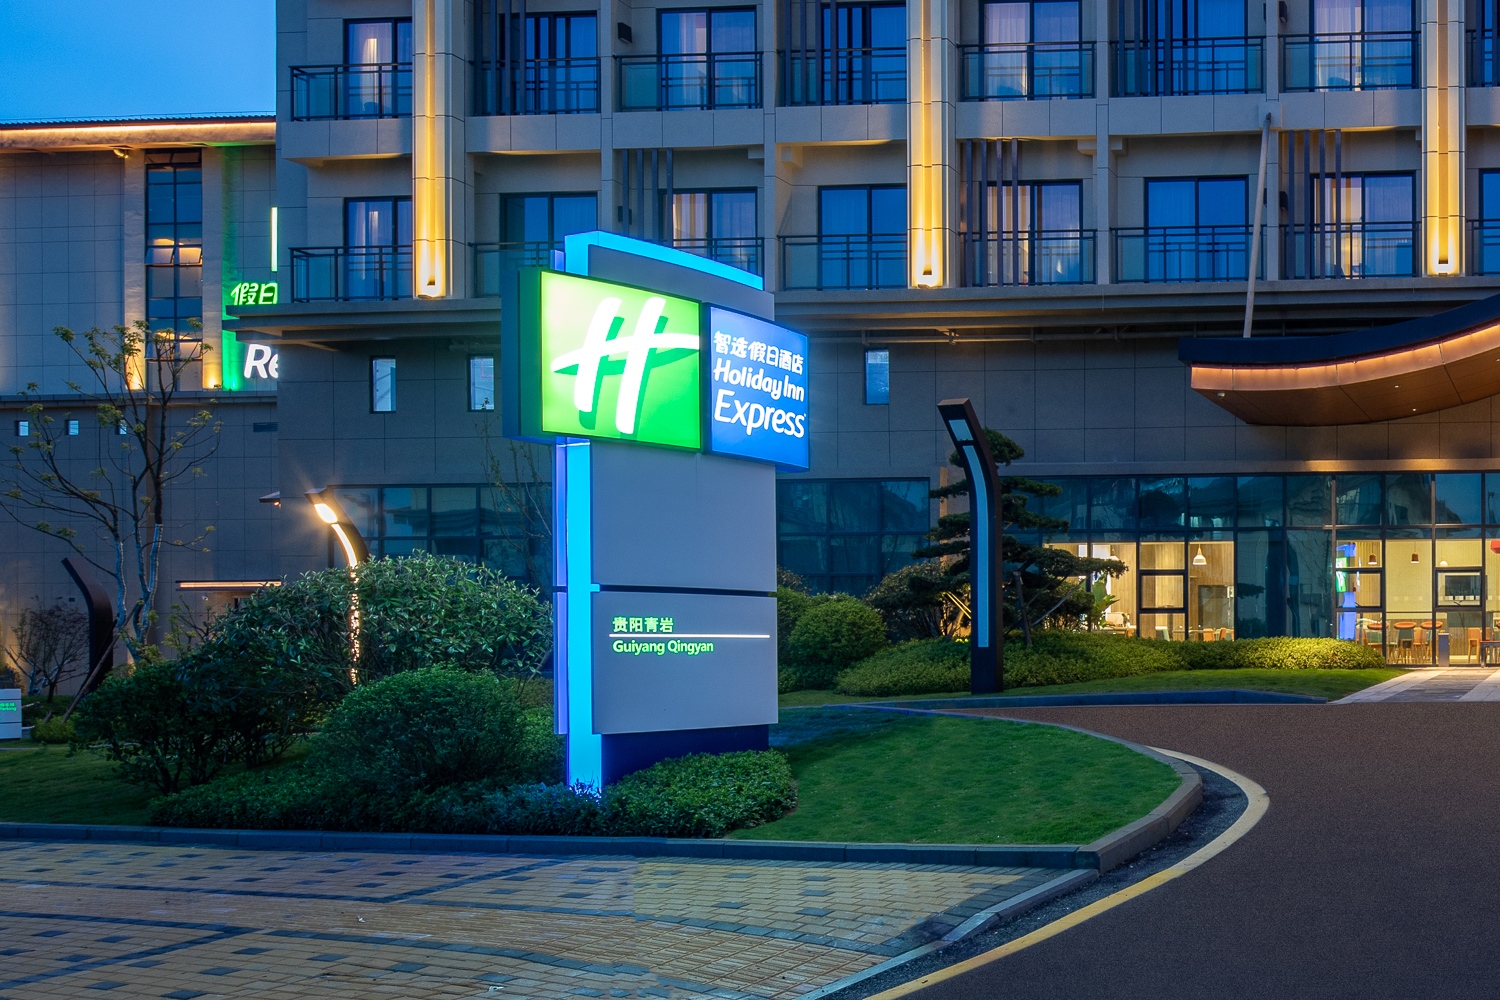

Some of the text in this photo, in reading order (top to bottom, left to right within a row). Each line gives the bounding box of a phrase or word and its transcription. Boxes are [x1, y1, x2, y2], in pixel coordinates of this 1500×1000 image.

[230, 282, 278, 305] 假日
[713, 330, 804, 375] 智选假日酒店
[713, 357, 804, 402] Holiday Inn
[714, 388, 805, 438] Express
[612, 617, 674, 633] 贵阳青岩
[612, 640, 714, 656] Guiyang Qingyan
